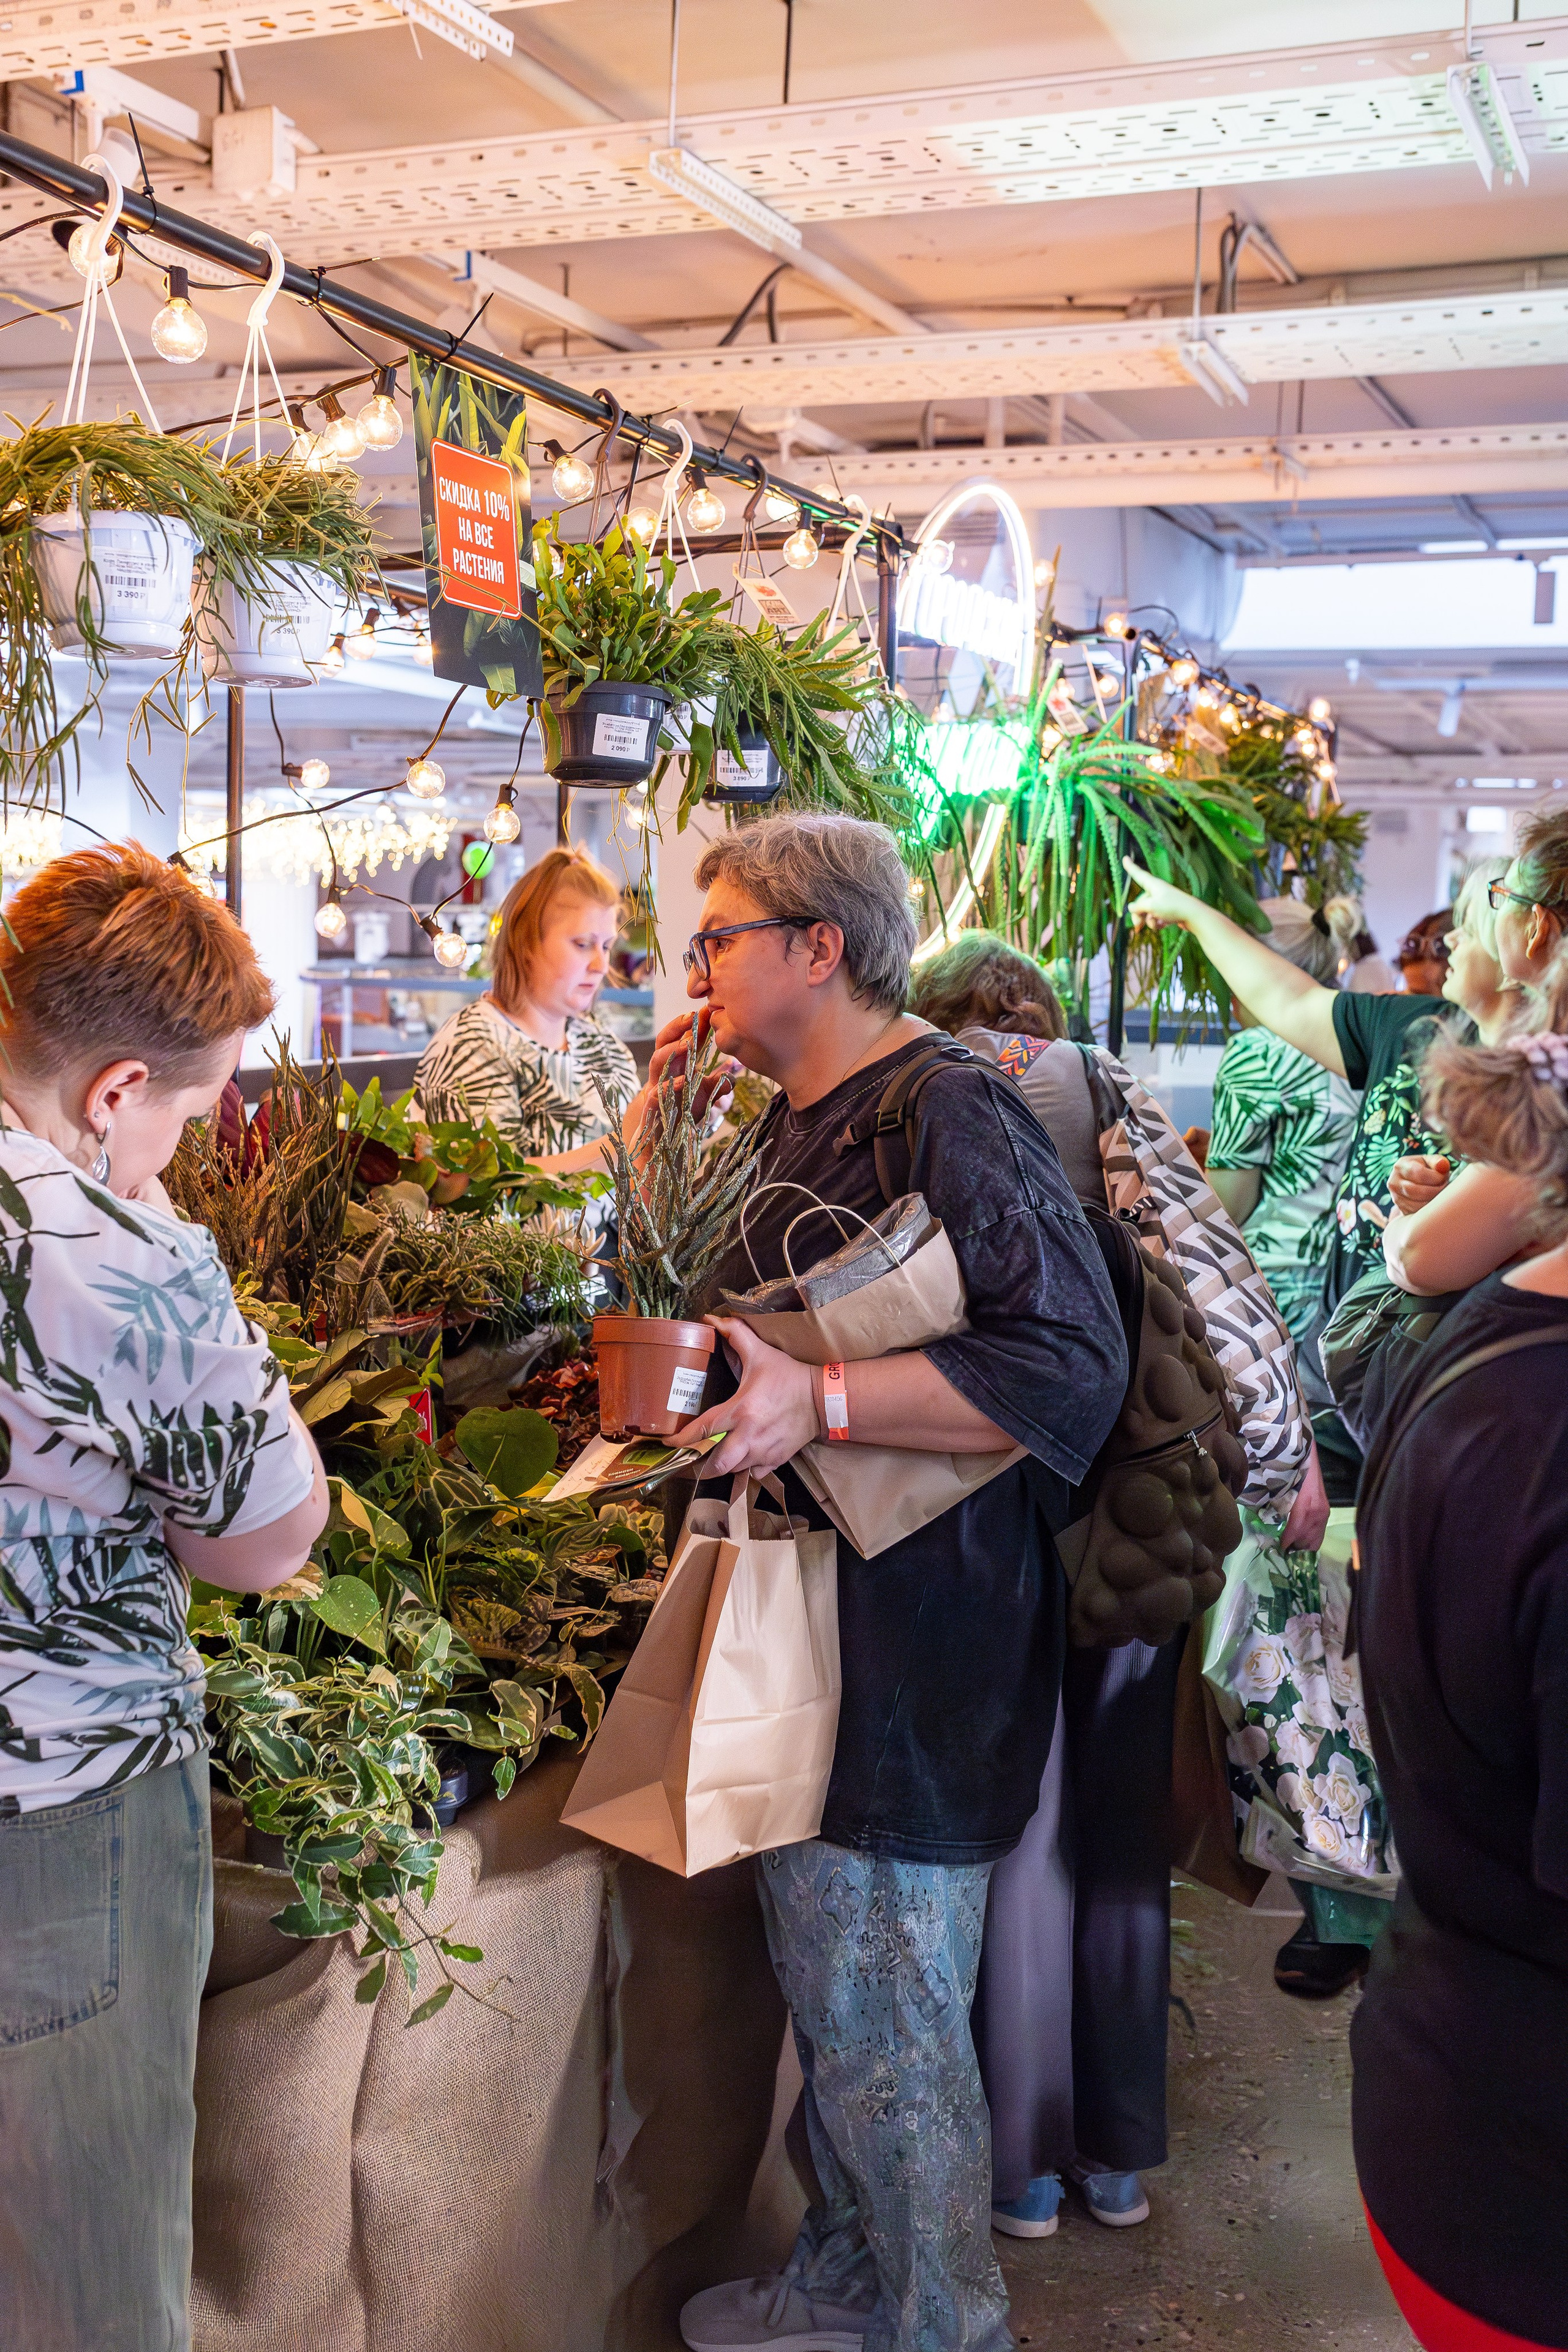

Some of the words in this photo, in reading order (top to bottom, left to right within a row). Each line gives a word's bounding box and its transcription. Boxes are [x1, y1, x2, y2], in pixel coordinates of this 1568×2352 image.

[439, 476, 481, 513] СКИДКА
[484, 489, 510, 522] 10%
[458, 516, 473, 543] НА
[474, 521, 494, 549] ВСЕ
[453, 547, 505, 584] РАСТЕНИЯ
